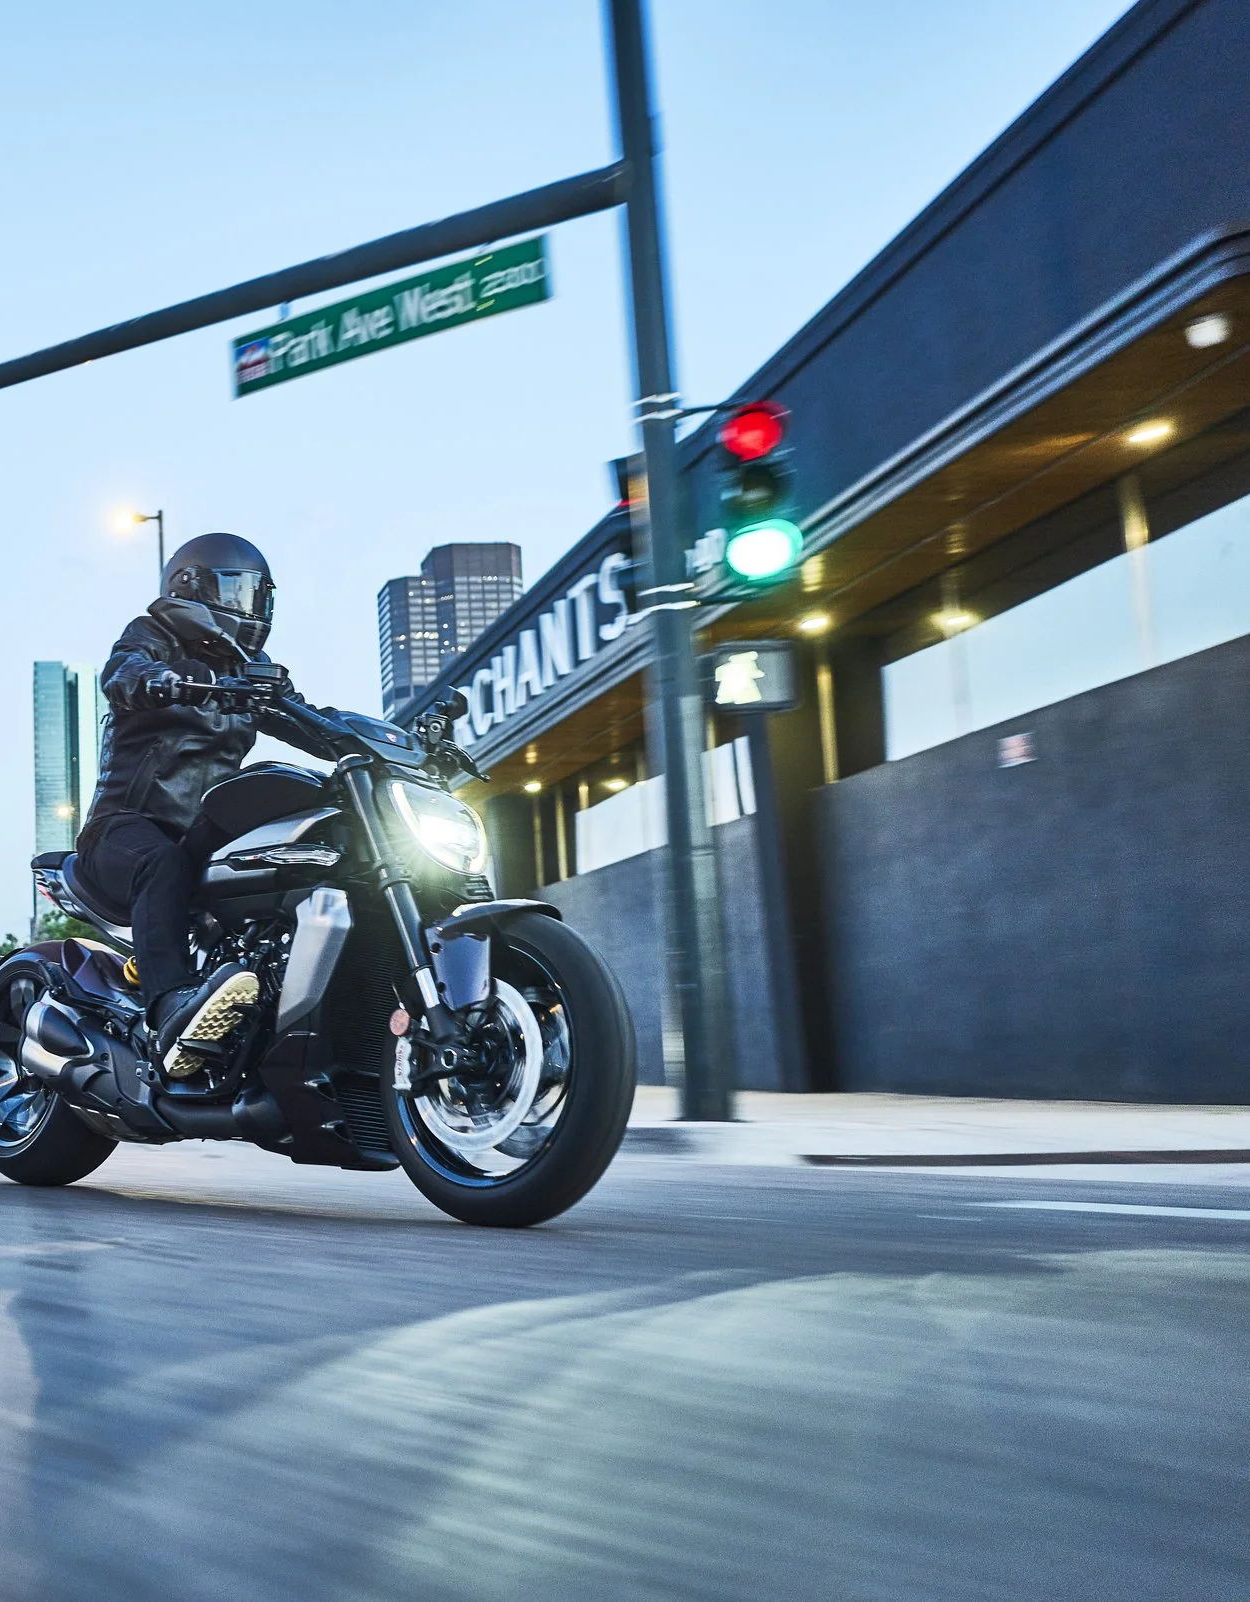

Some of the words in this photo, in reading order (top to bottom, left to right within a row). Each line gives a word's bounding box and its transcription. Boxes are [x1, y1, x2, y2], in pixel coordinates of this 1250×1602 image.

[268, 320, 335, 374] Park
[335, 305, 395, 352] Ave
[394, 271, 477, 331] West
